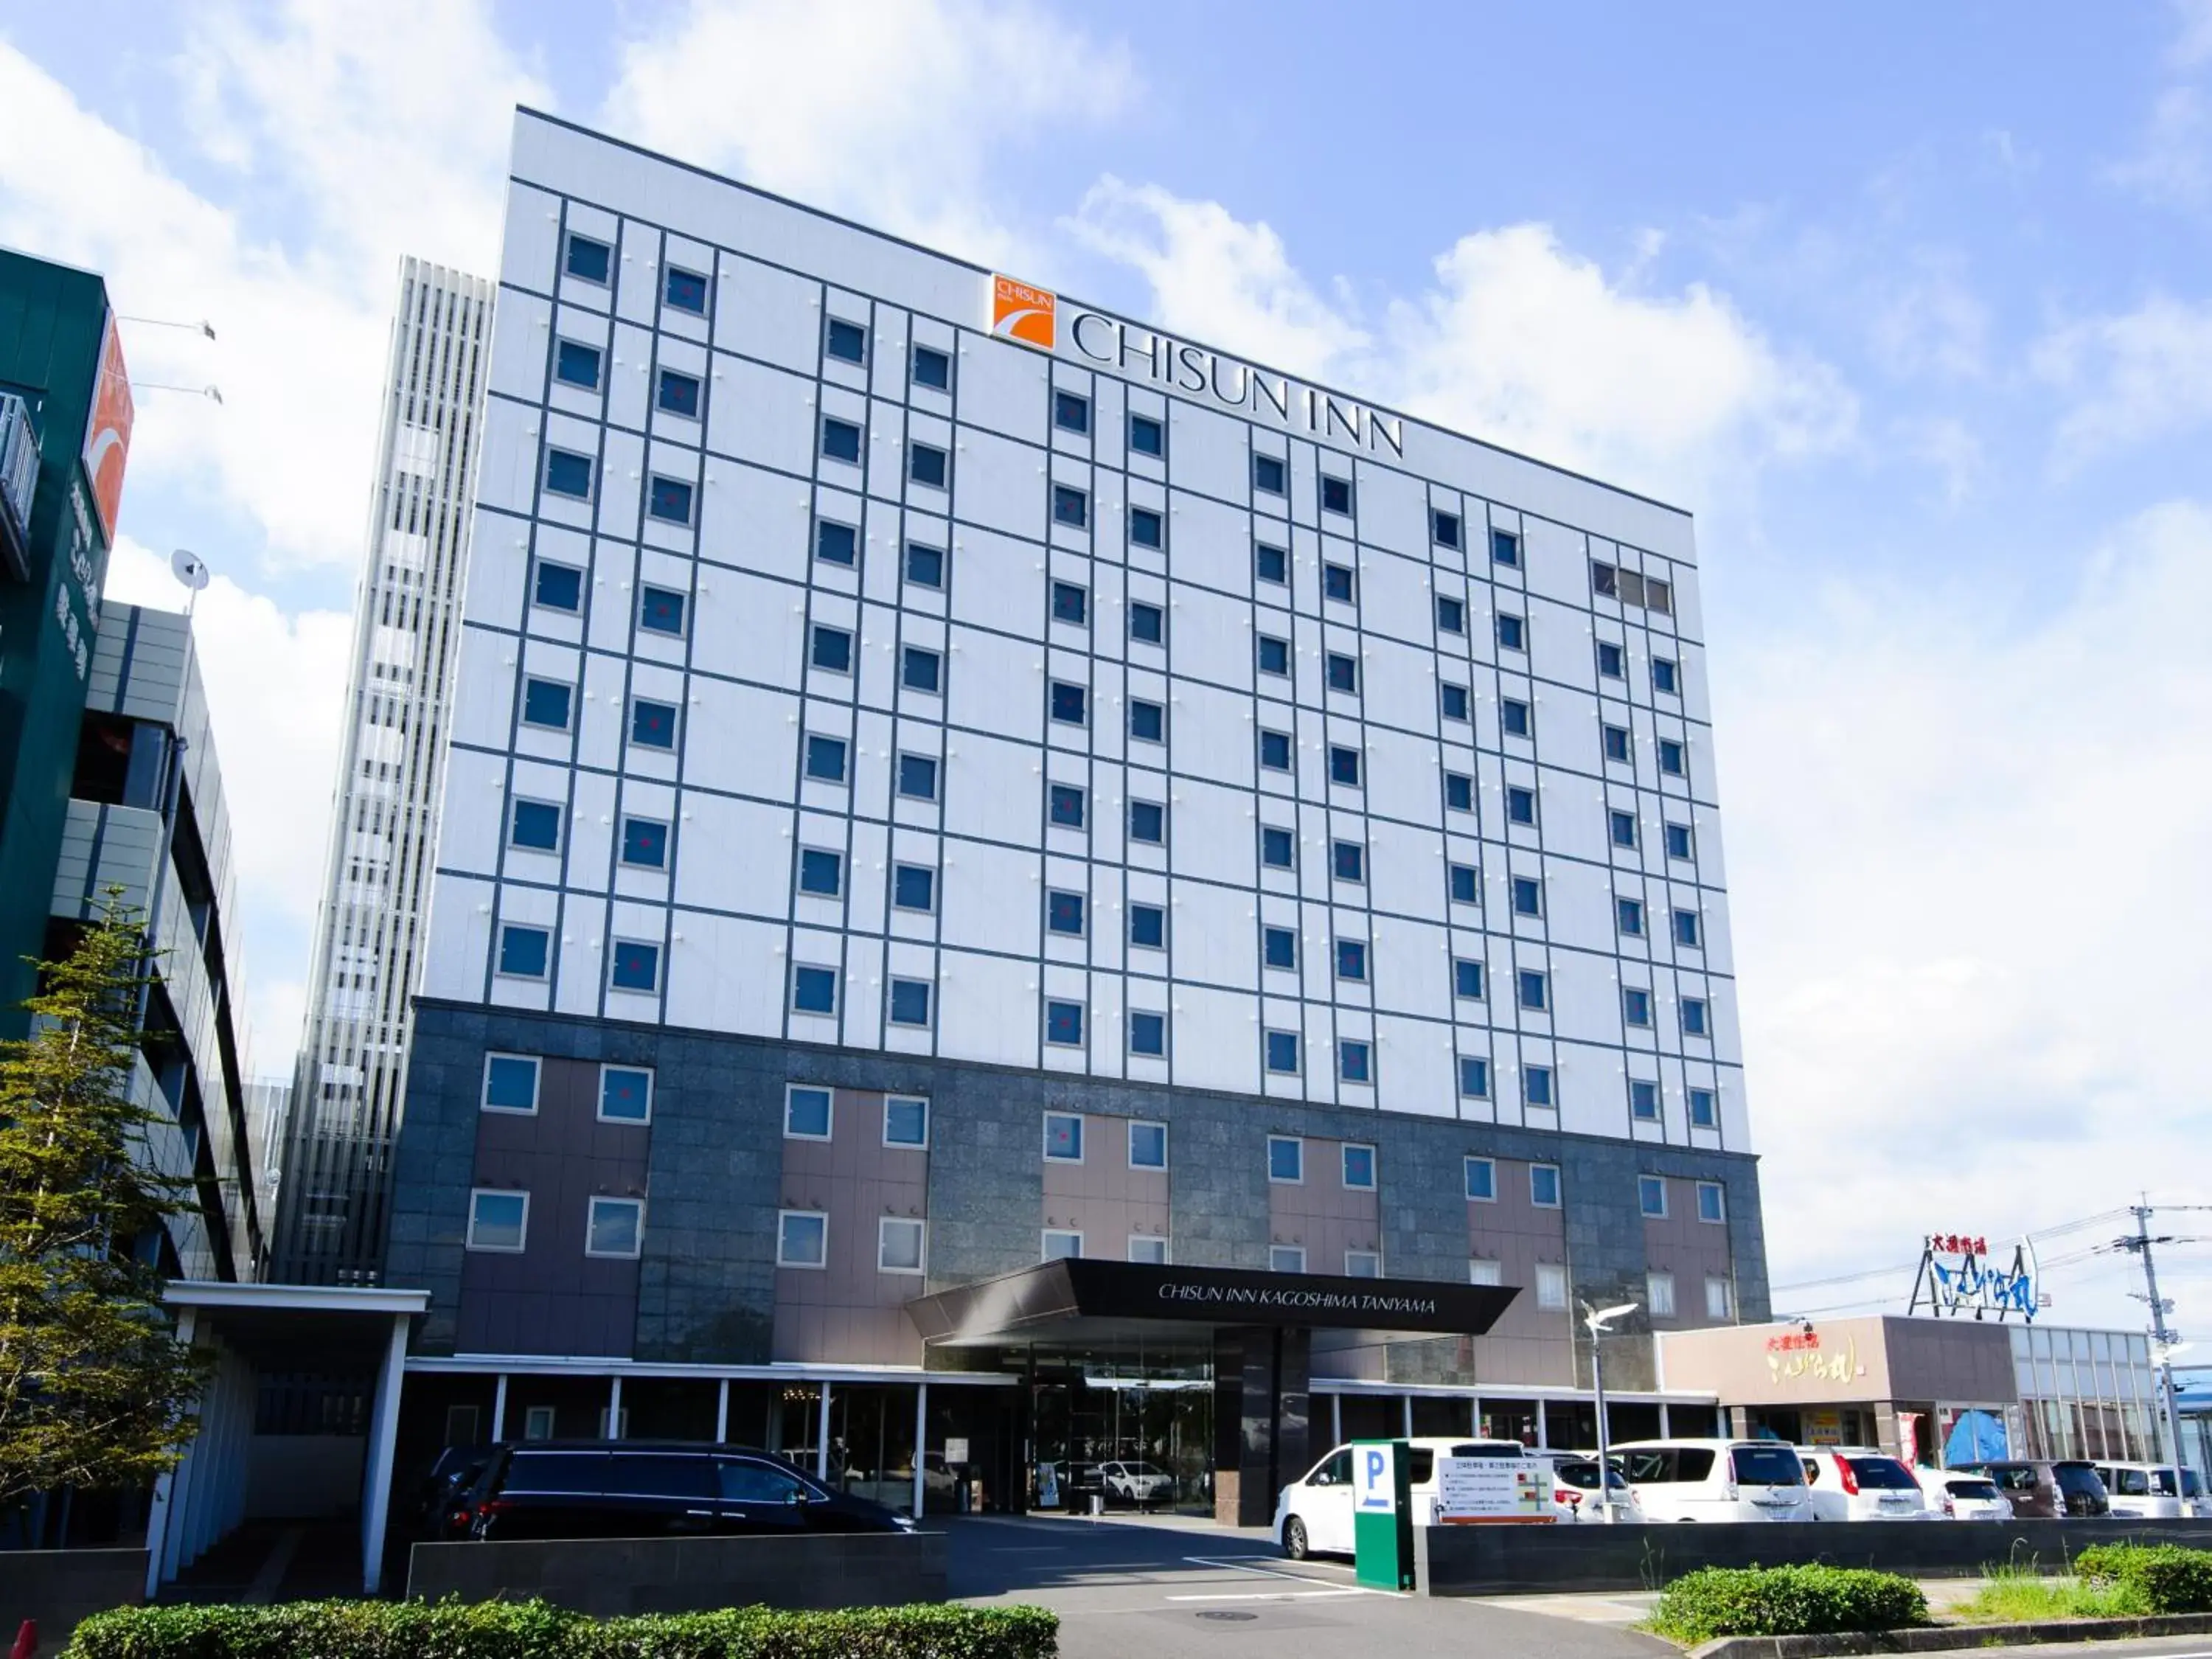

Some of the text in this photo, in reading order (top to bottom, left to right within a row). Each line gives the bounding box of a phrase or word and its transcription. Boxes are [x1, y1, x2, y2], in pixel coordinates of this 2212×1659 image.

[997, 280, 1052, 308] CHISUN
[1071, 312, 1404, 460] CHISUN INN
[1158, 1283, 1436, 1314] CHISUN INN KAGOSHIMA TANIYAMA
[1366, 1450, 1385, 1489] P
